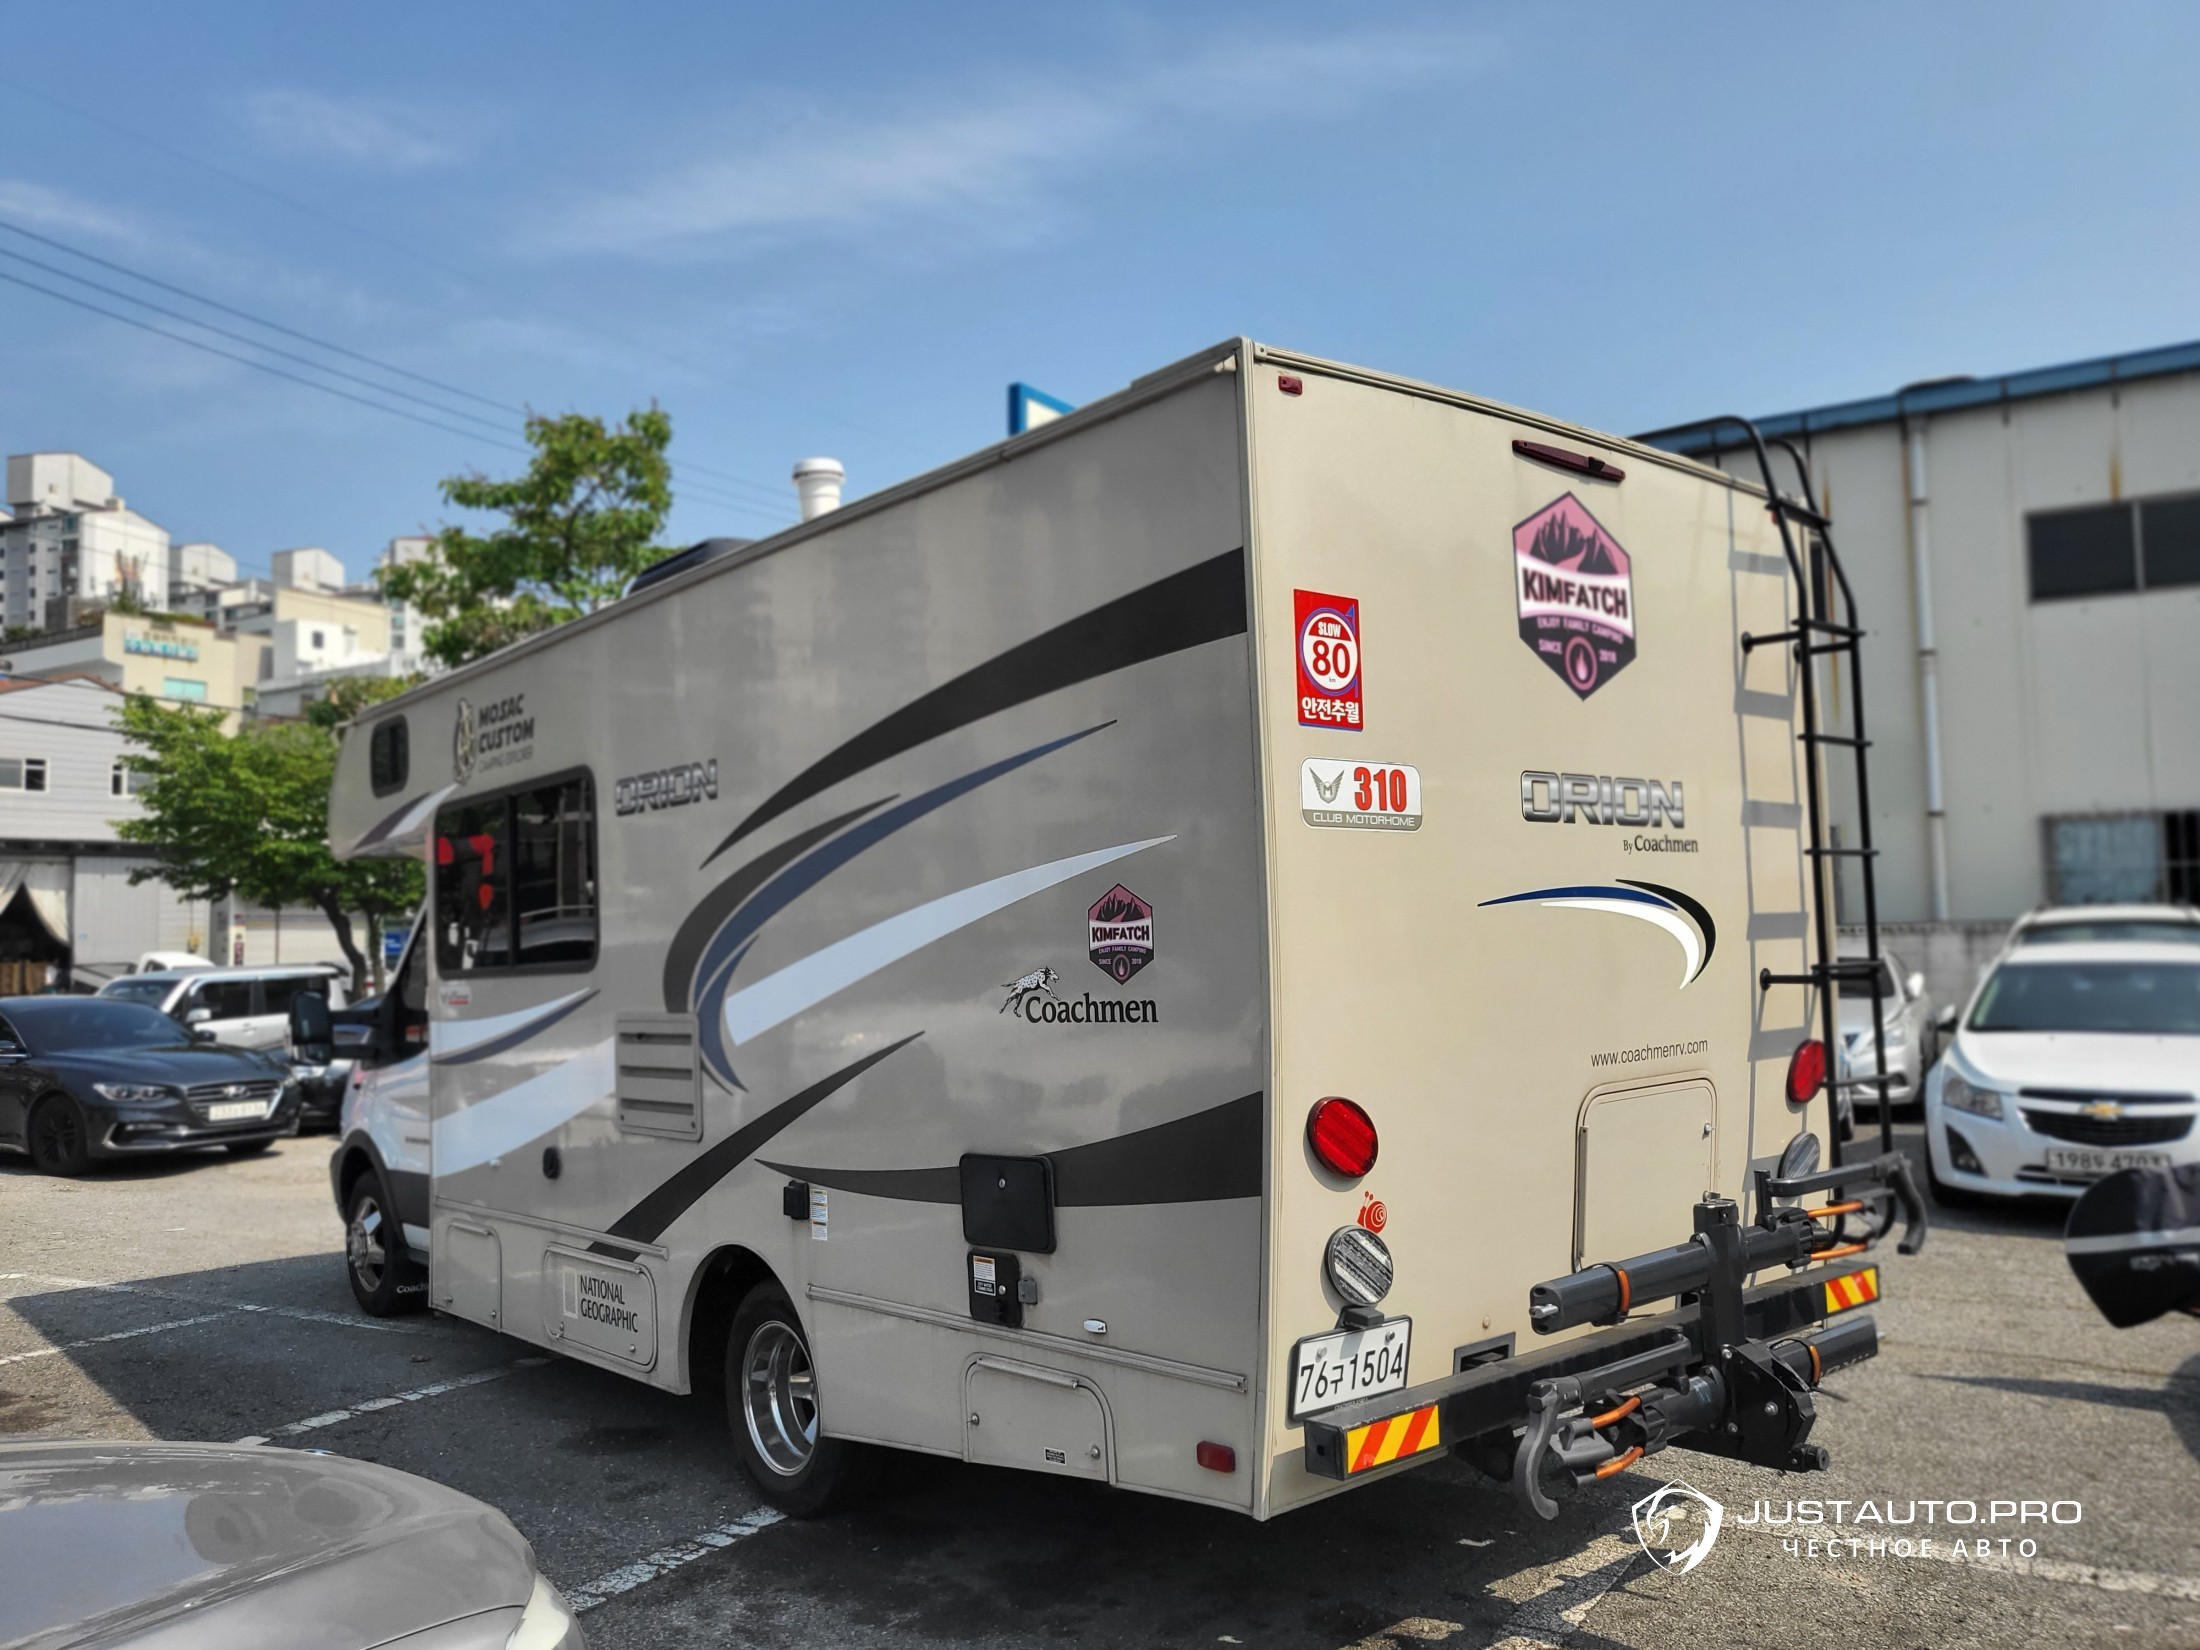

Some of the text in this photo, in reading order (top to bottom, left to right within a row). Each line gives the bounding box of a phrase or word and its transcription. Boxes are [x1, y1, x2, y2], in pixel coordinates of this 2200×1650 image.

[1522, 567, 1628, 619] KIMFATCH
[1318, 621, 1341, 638] SLOW
[1312, 640, 1351, 679] 80
[479, 693, 524, 729] MOSAC
[1301, 697, 1360, 724] 안전추월
[479, 716, 535, 754] CUSTOM
[615, 758, 718, 817] ORION
[1354, 766, 1407, 812] 310
[1520, 769, 1685, 829] ORION
[1313, 812, 1415, 827] CLUB MOTORHOME
[1623, 835, 1698, 855] By Coachmen
[1091, 925, 1150, 943] KIMFATCH
[1025, 992, 1159, 1023] Coachmen
[1590, 1039, 1708, 1067] www.coachmenrv.com
[580, 1274, 625, 1305] NATIONAL
[580, 1298, 638, 1333] GEOGRAPHIC
